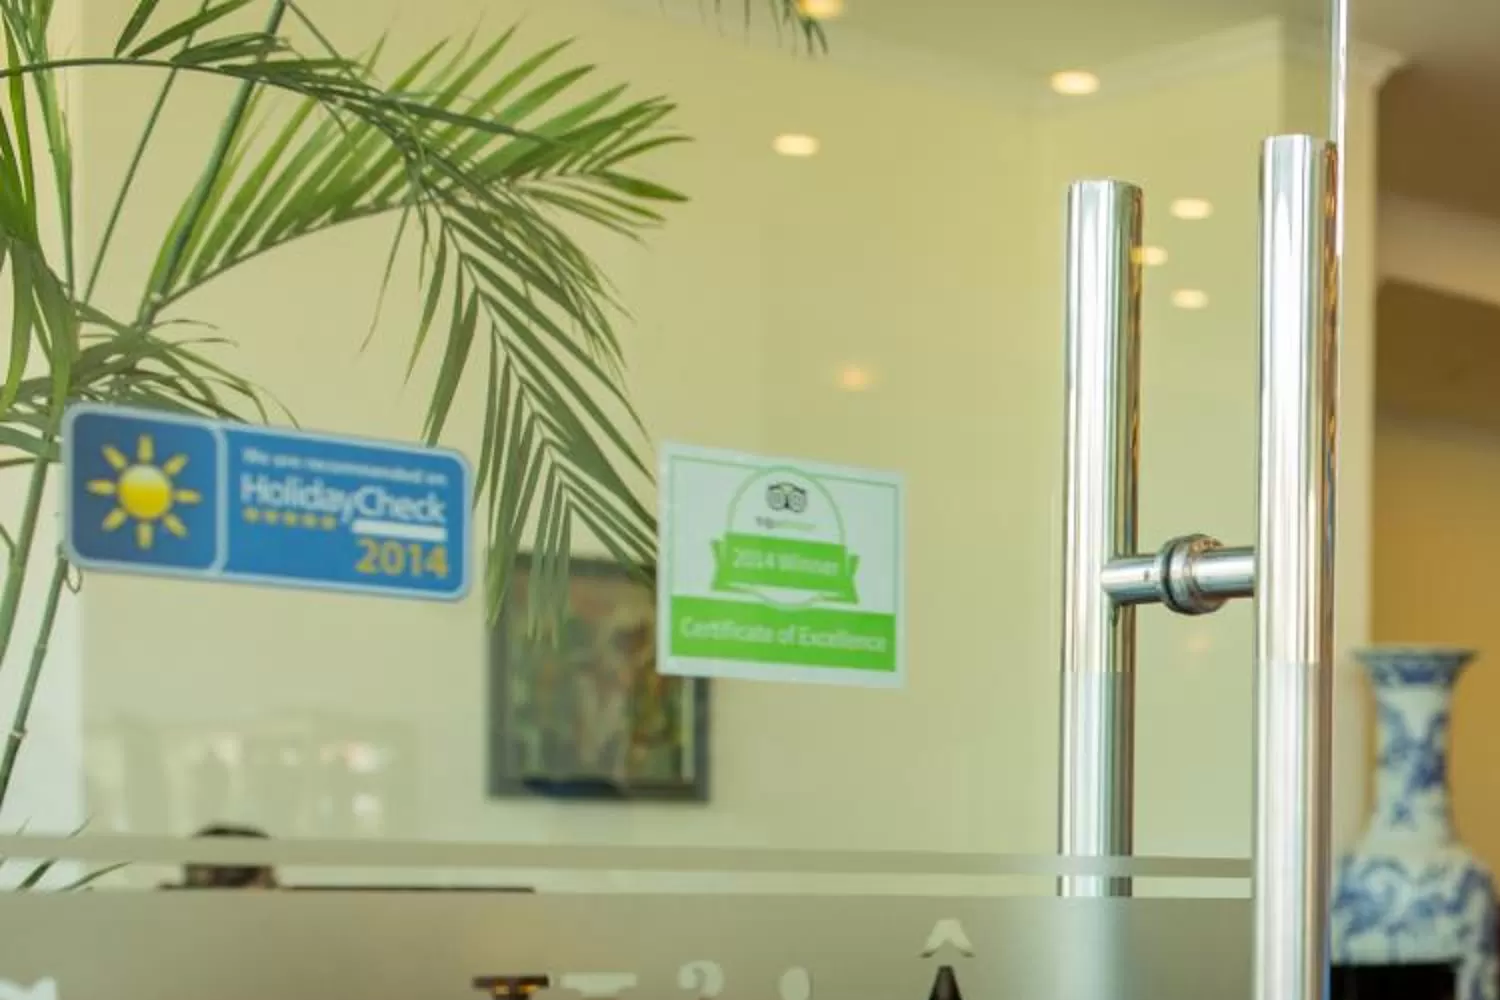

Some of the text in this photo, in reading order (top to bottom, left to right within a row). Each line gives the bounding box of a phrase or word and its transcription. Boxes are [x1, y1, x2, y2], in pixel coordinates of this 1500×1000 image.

[240, 472, 447, 524] HolidayCheck
[355, 537, 448, 579] 2014
[680, 616, 774, 644] Certificate
